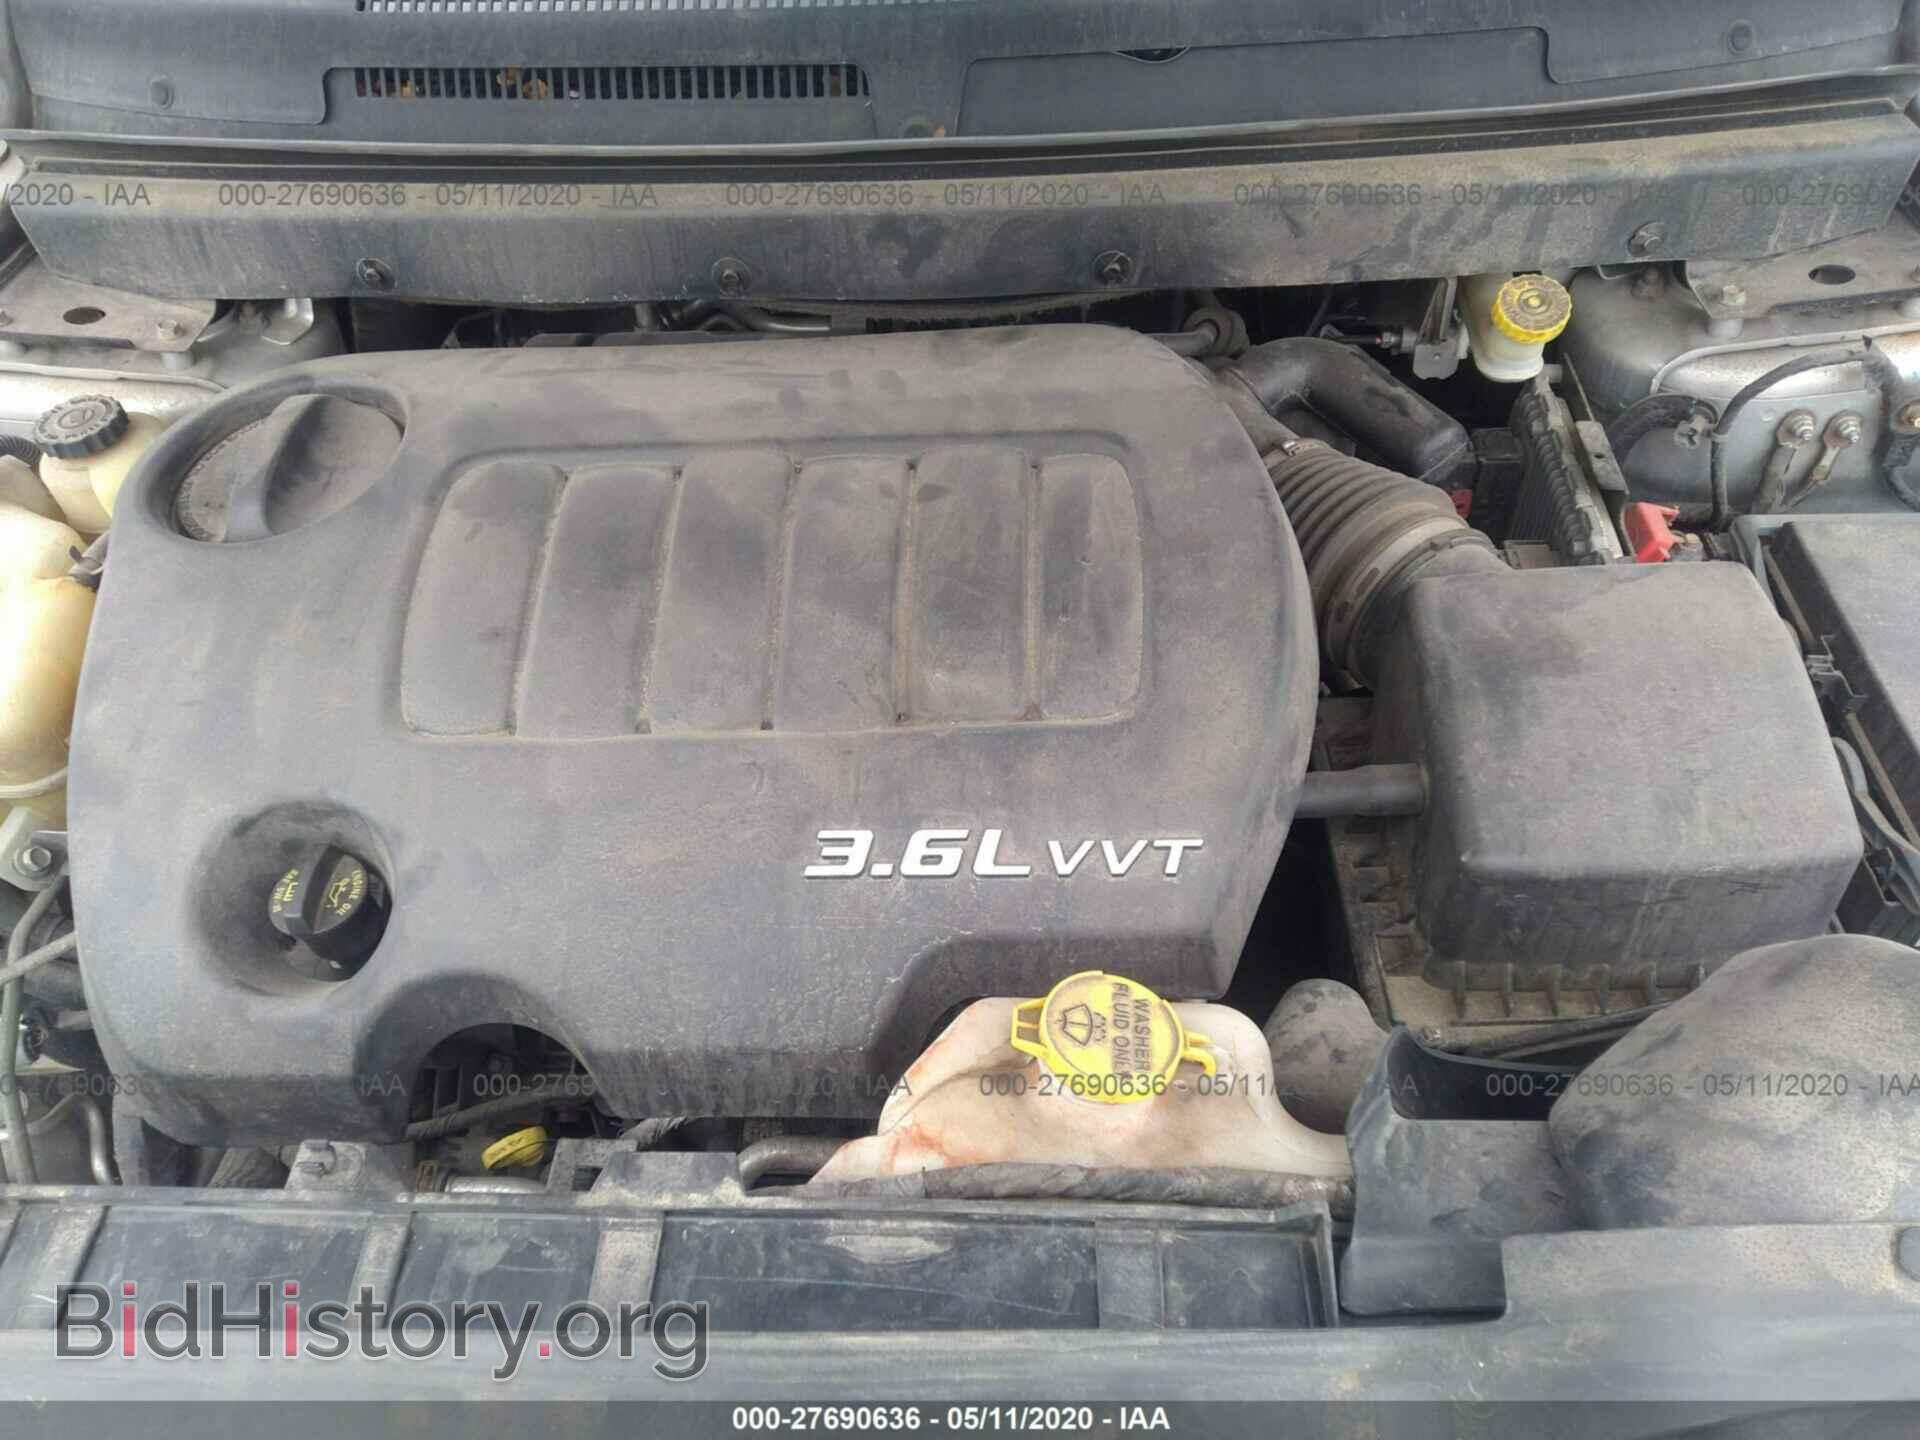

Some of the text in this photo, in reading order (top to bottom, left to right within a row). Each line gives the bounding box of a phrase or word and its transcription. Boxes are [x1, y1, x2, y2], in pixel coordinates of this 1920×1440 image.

[803, 828, 1204, 878] 3.6L VVT
[350, 869, 363, 899] ENGINE
[1111, 982, 1131, 1027] FLUID
[1134, 997, 1151, 1073] WASHER
